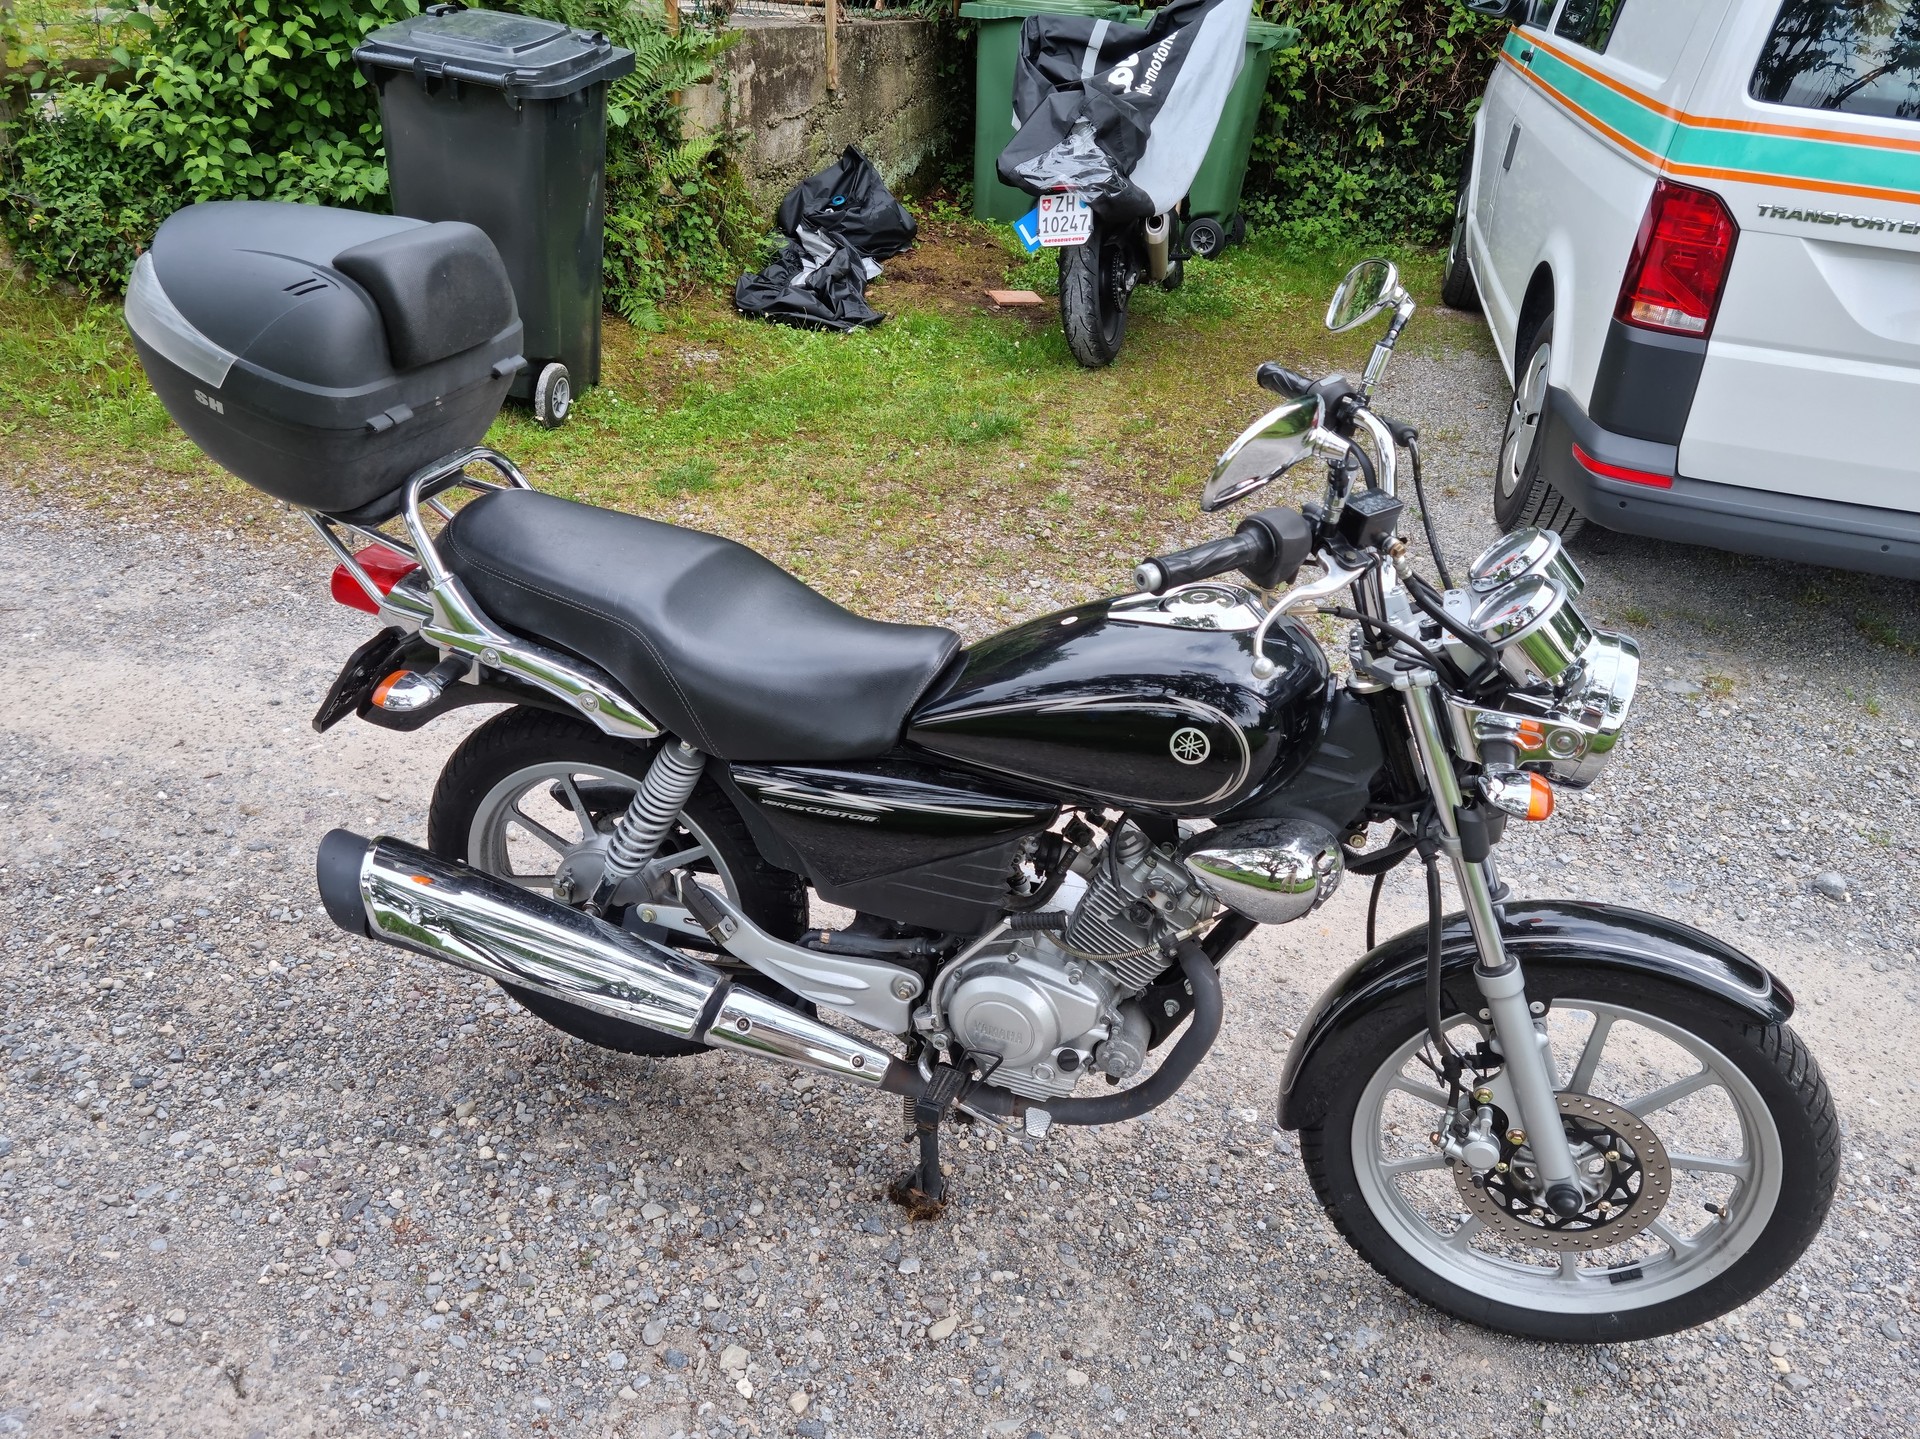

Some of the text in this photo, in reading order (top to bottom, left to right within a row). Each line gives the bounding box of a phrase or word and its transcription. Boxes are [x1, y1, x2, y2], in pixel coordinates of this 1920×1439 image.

[1055, 195, 1076, 213] ZH
[1042, 214, 1089, 234] 10247
[194, 389, 225, 415] SH
[805, 806, 878, 822] CUSTOM
